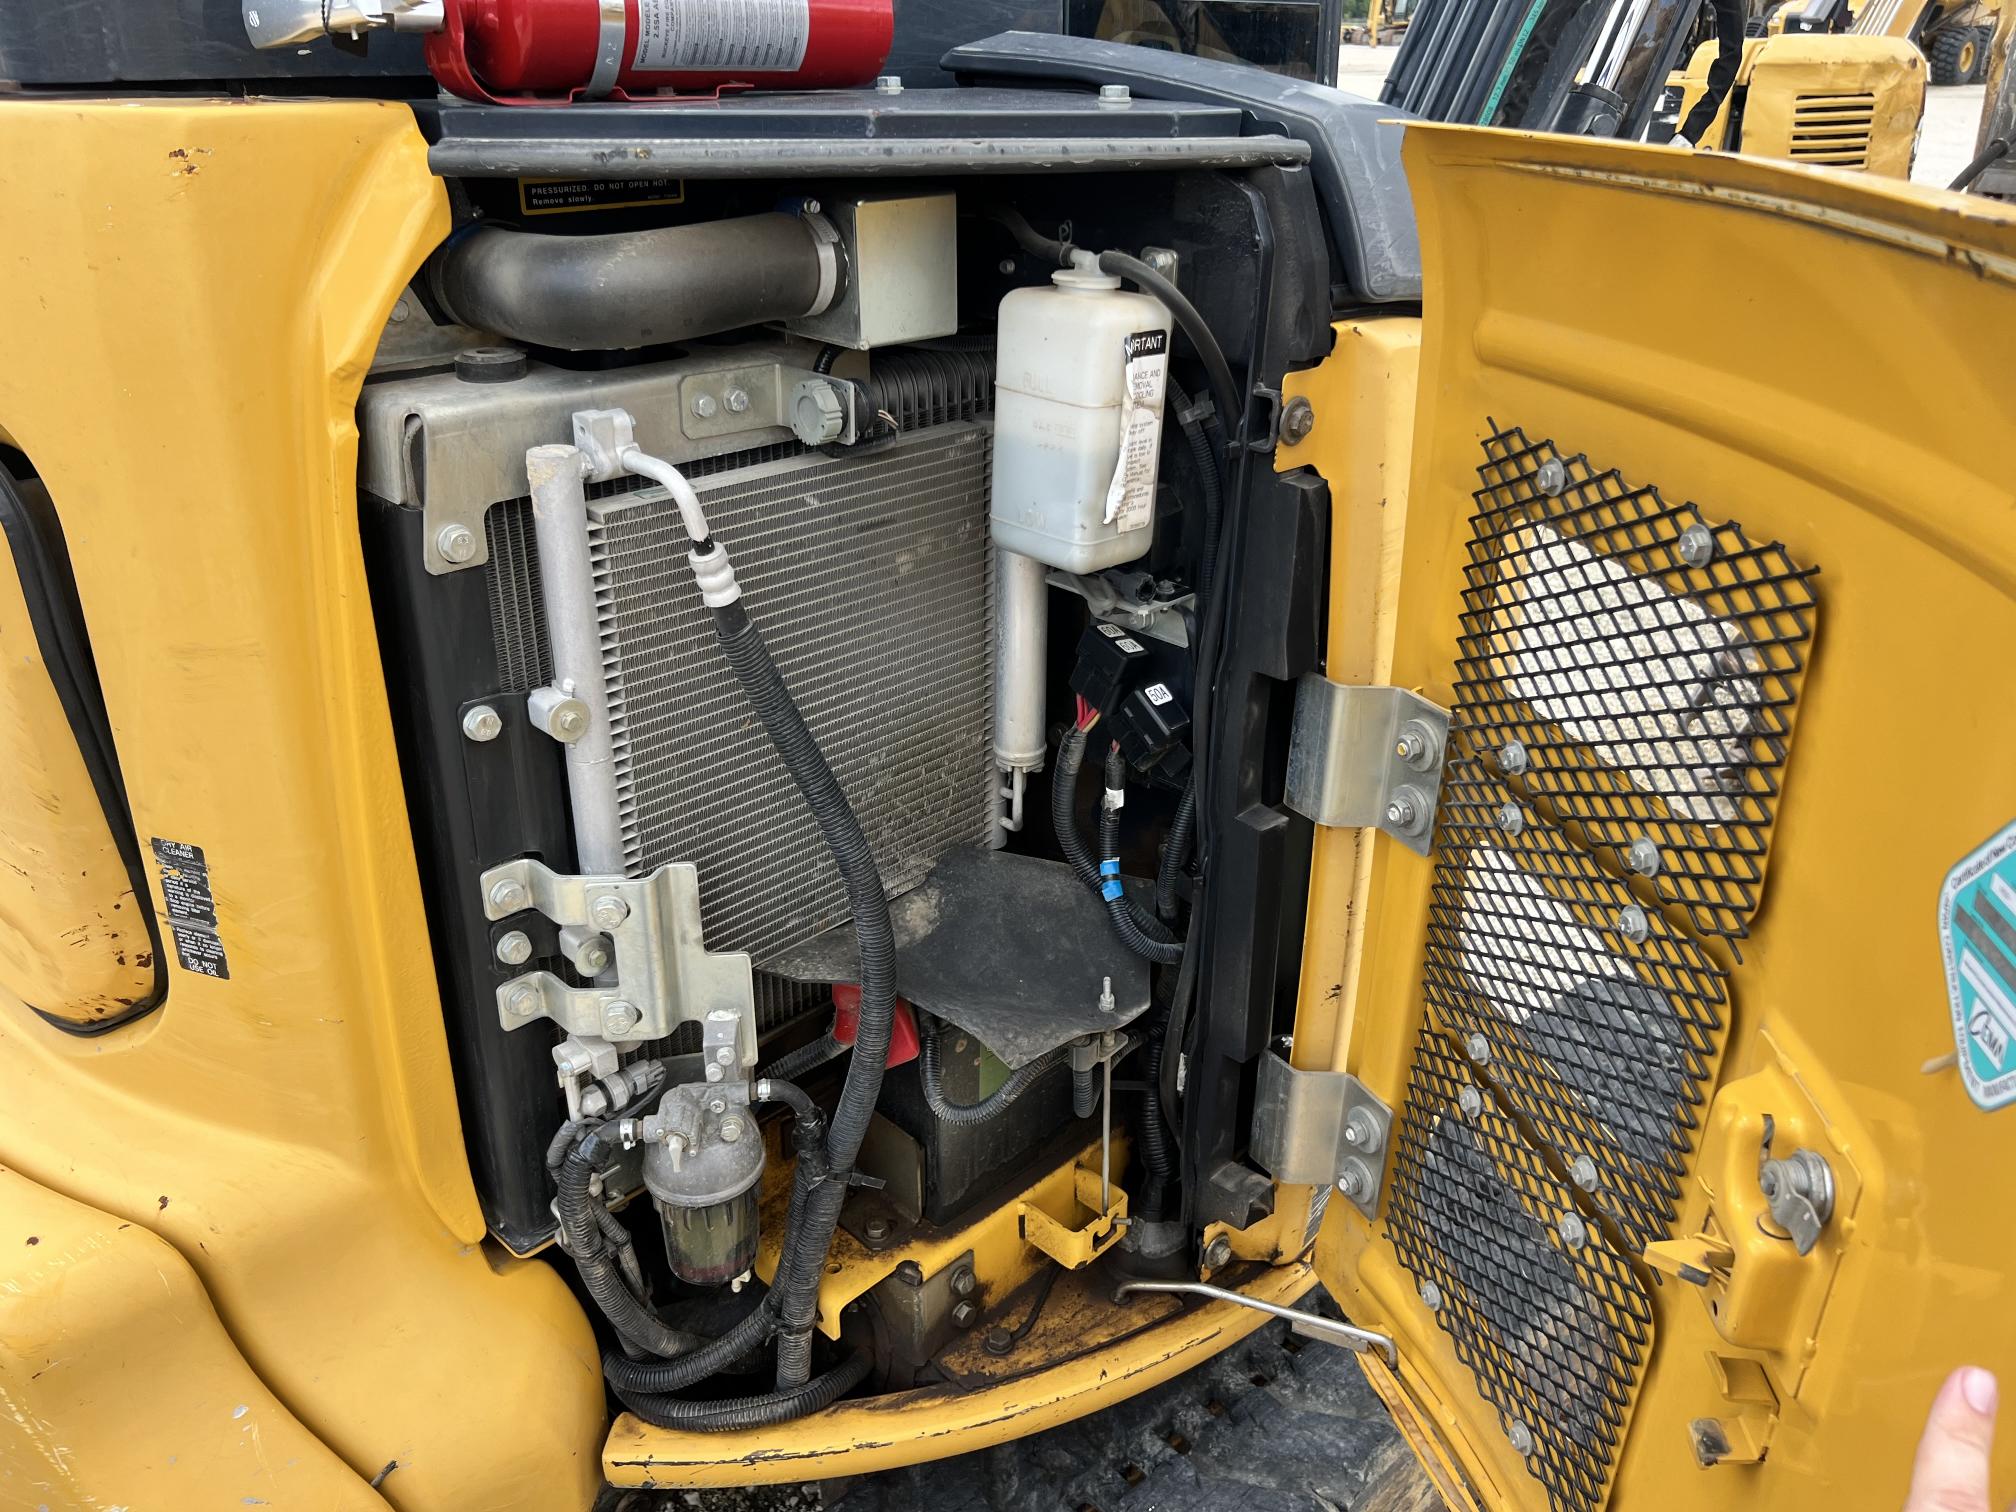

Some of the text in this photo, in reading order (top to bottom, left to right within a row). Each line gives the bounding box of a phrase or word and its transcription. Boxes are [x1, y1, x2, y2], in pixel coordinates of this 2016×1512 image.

[640, 38, 650, 63] MODEL
[594, 183, 605, 191] DO
[609, 182, 624, 190] NOT
[628, 180, 649, 189] OPEN
[532, 197, 564, 206] Remove
[1150, 368, 1161, 378] AND
[1148, 686, 1170, 702] 50A
[162, 847, 194, 859] CLEANER
[179, 843, 193, 852] AIR
[187, 957, 217, 969] DO NOT
[189, 964, 220, 977] USE OIL
